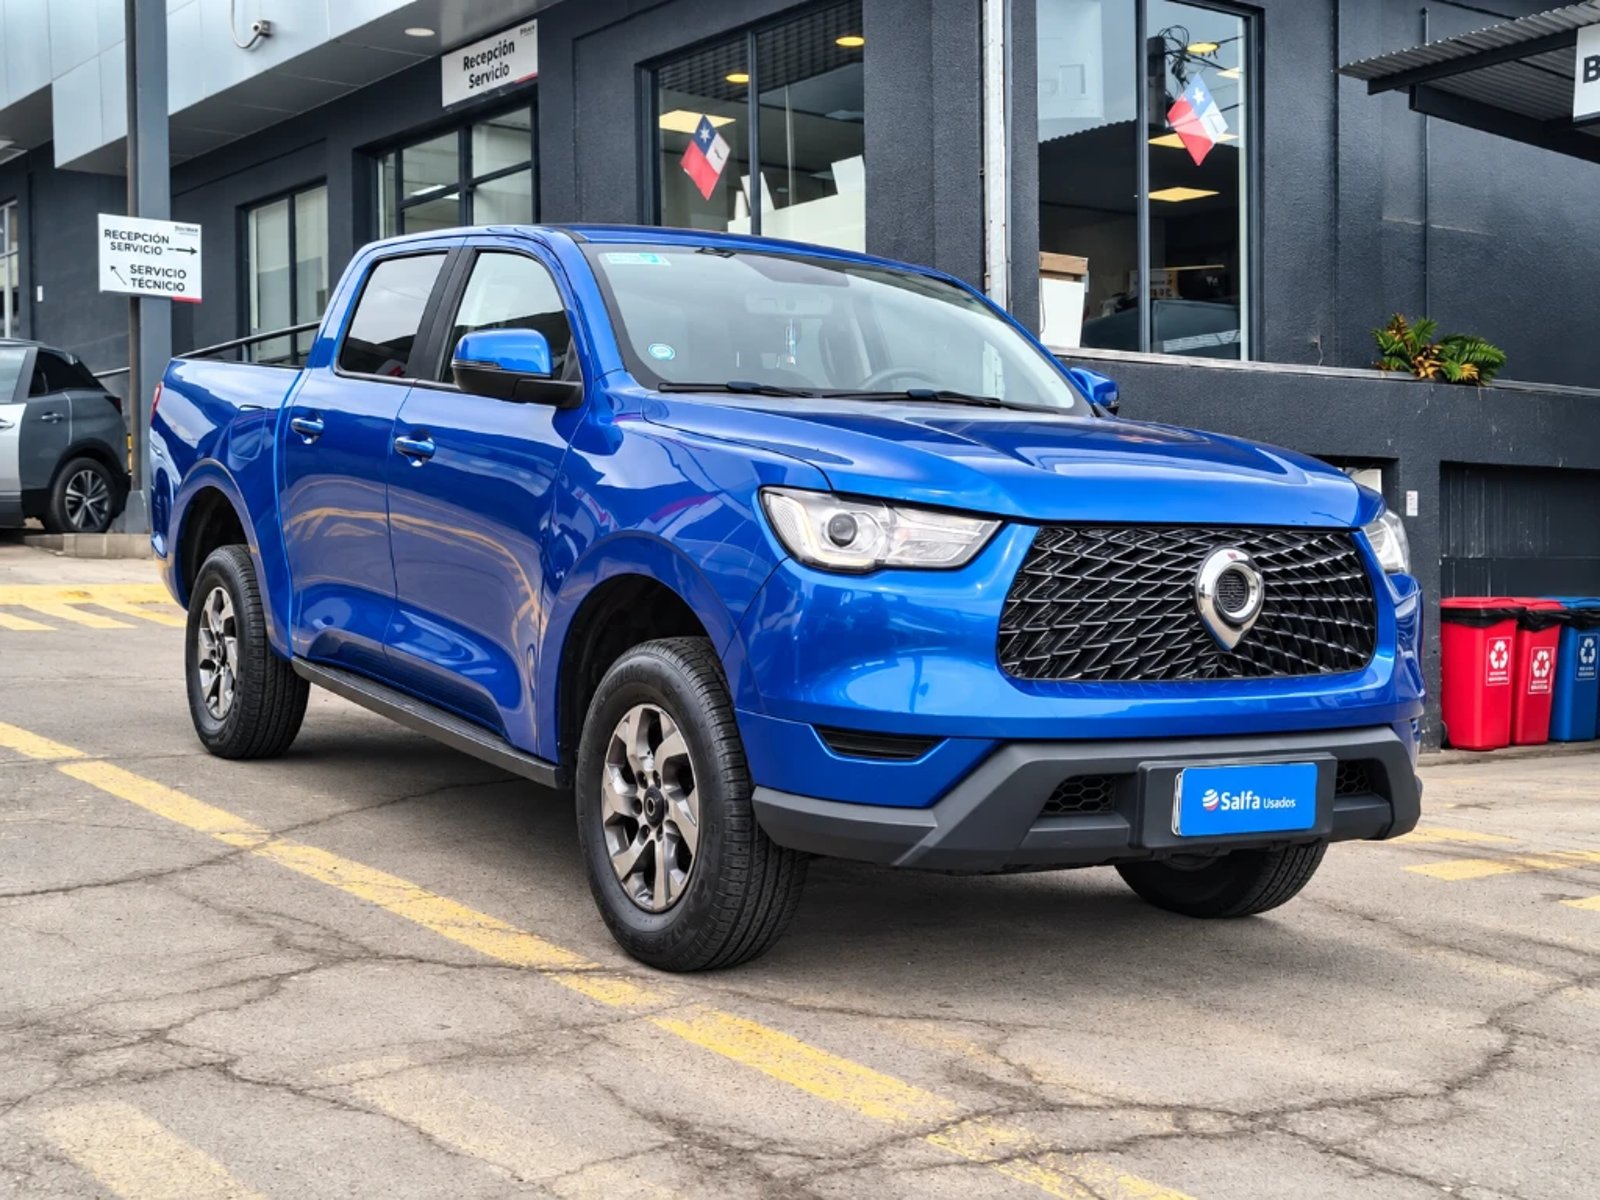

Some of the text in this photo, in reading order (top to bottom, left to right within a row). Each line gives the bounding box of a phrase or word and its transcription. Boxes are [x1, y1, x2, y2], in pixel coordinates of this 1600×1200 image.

[463, 40, 515, 71] Recepción
[468, 62, 510, 89] Servicio
[104, 229, 170, 244] RECEPCIÓN
[110, 241, 163, 255] SERVICIO
[129, 264, 187, 279] SERVICIO
[1221, 791, 1296, 811] Salfa Usados
